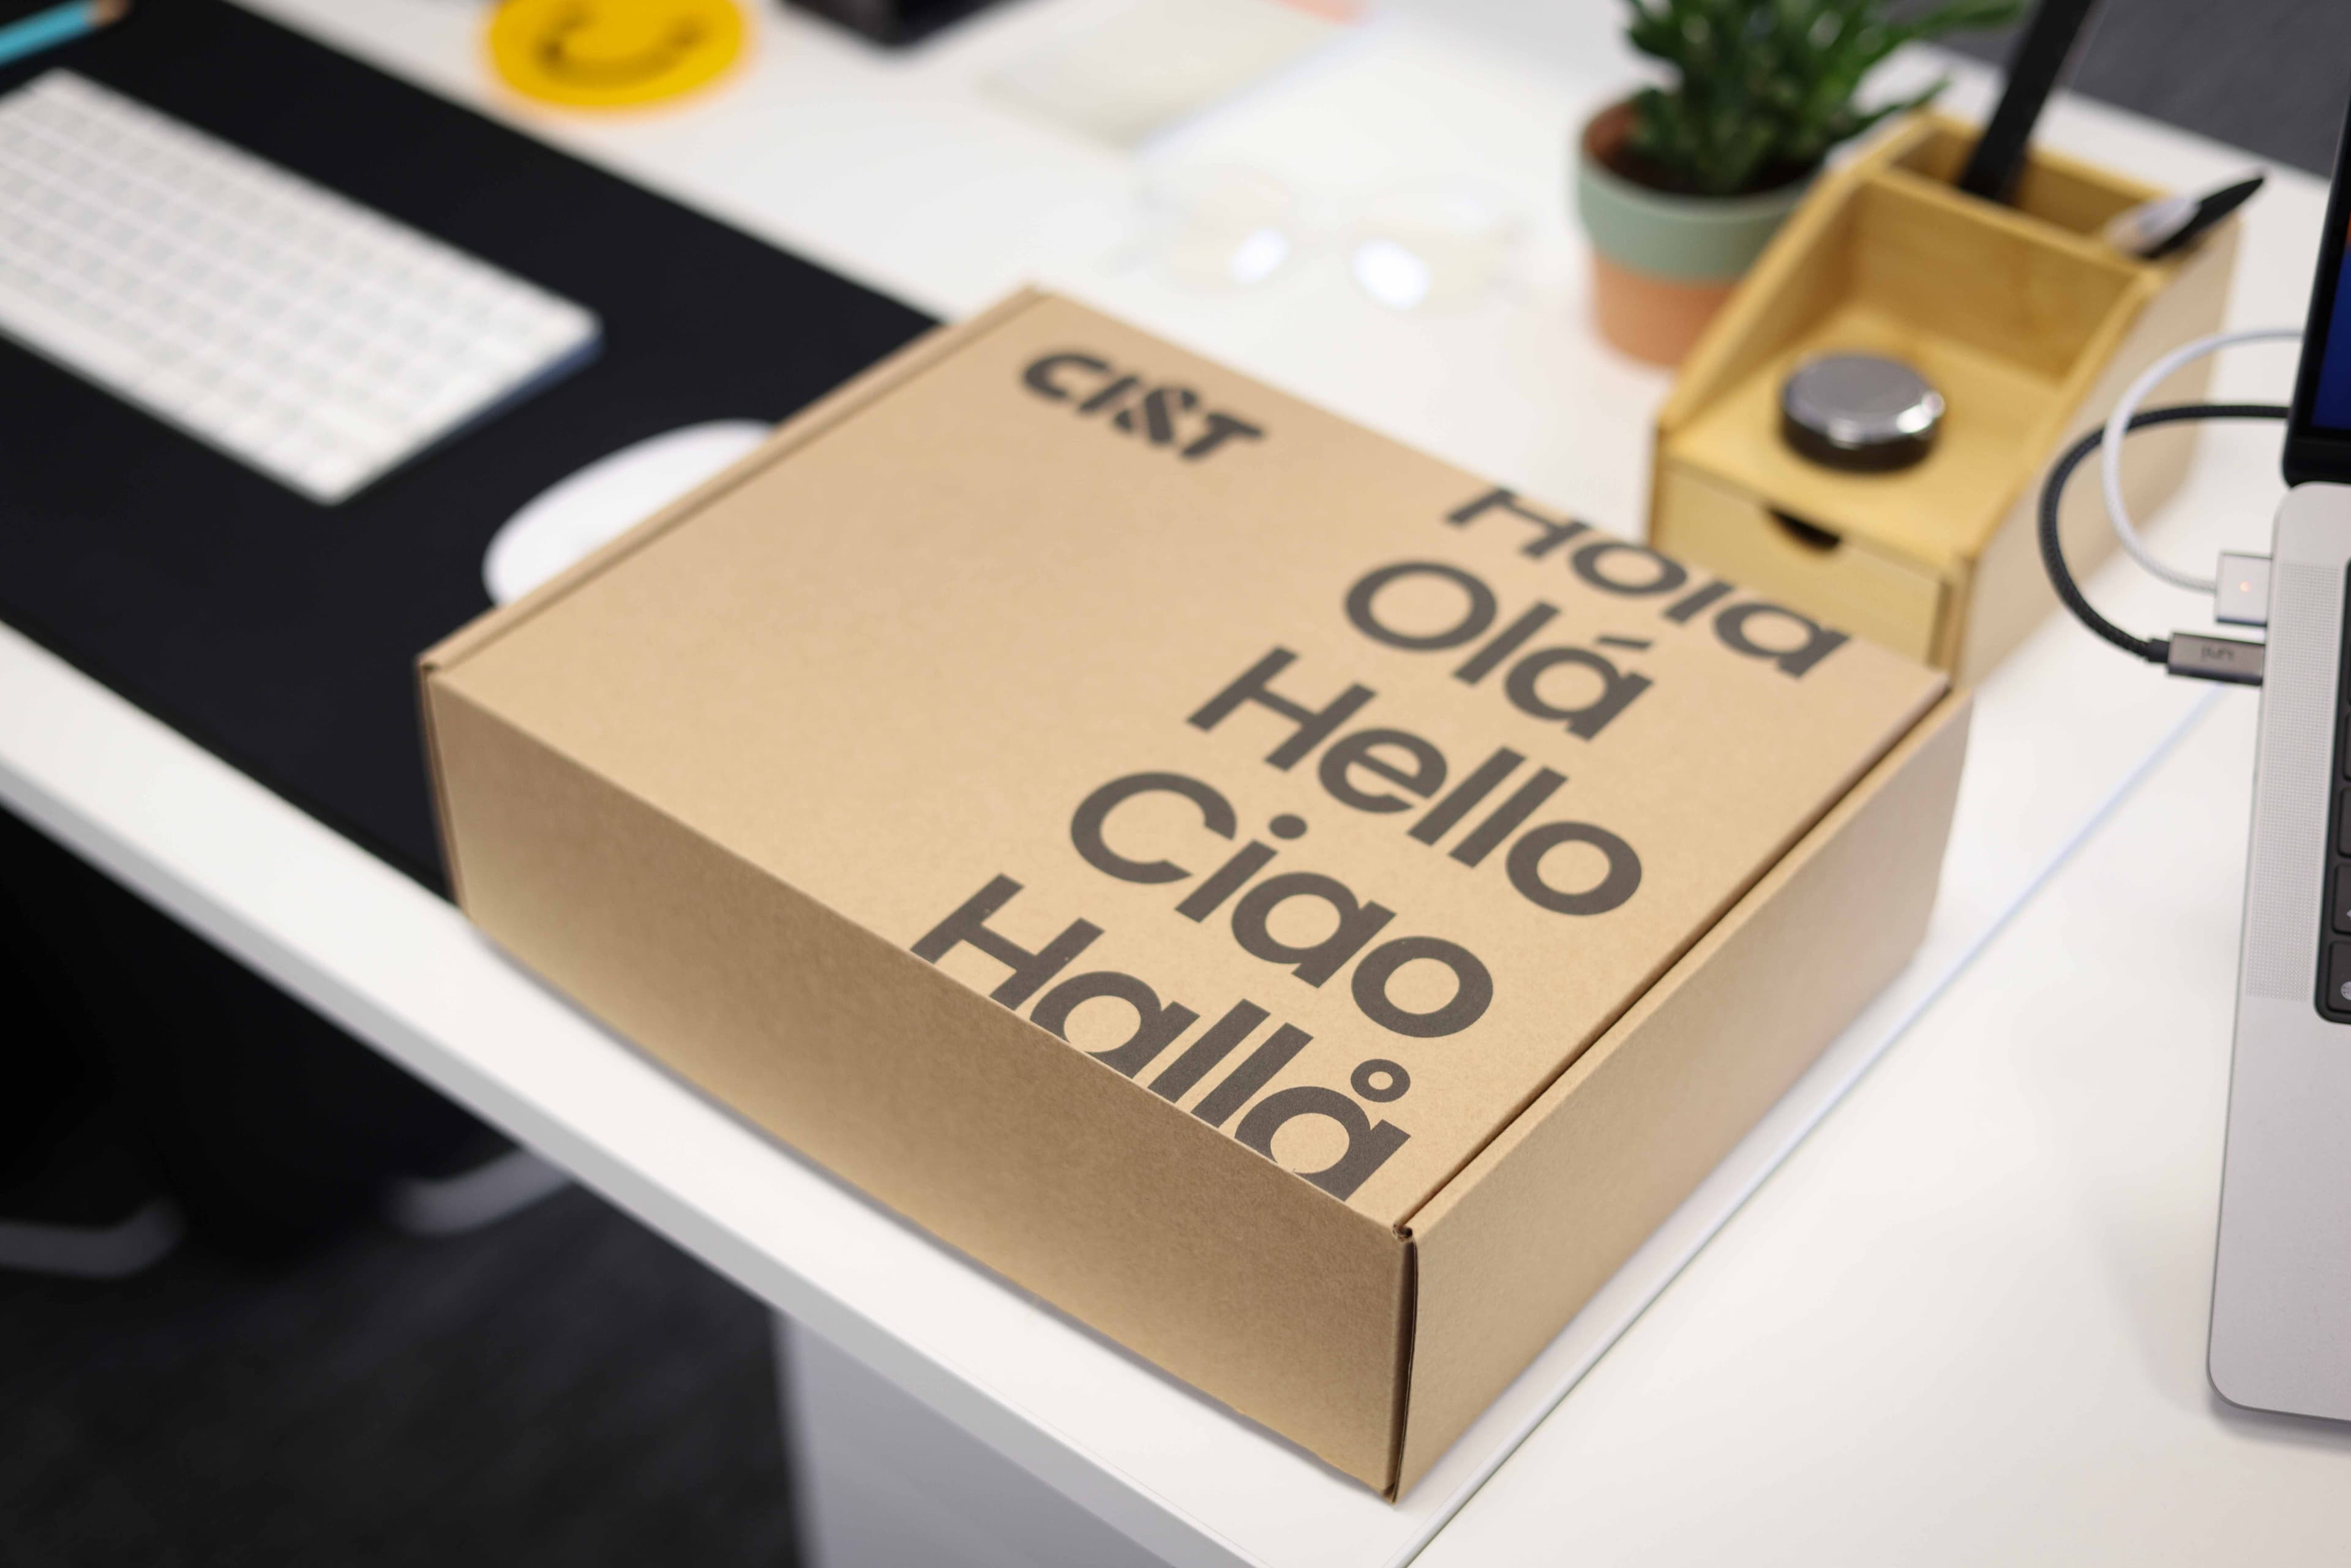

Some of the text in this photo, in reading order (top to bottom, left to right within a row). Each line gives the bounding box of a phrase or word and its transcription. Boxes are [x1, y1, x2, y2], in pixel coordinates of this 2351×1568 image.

[1020, 351, 1265, 461] CI&T
[1344, 561, 1653, 741] Olá
[1445, 487, 1850, 680] Hola
[1187, 647, 1643, 917] Hello
[1070, 772, 1493, 1038] Ciao
[910, 874, 1411, 1199] Hallå
